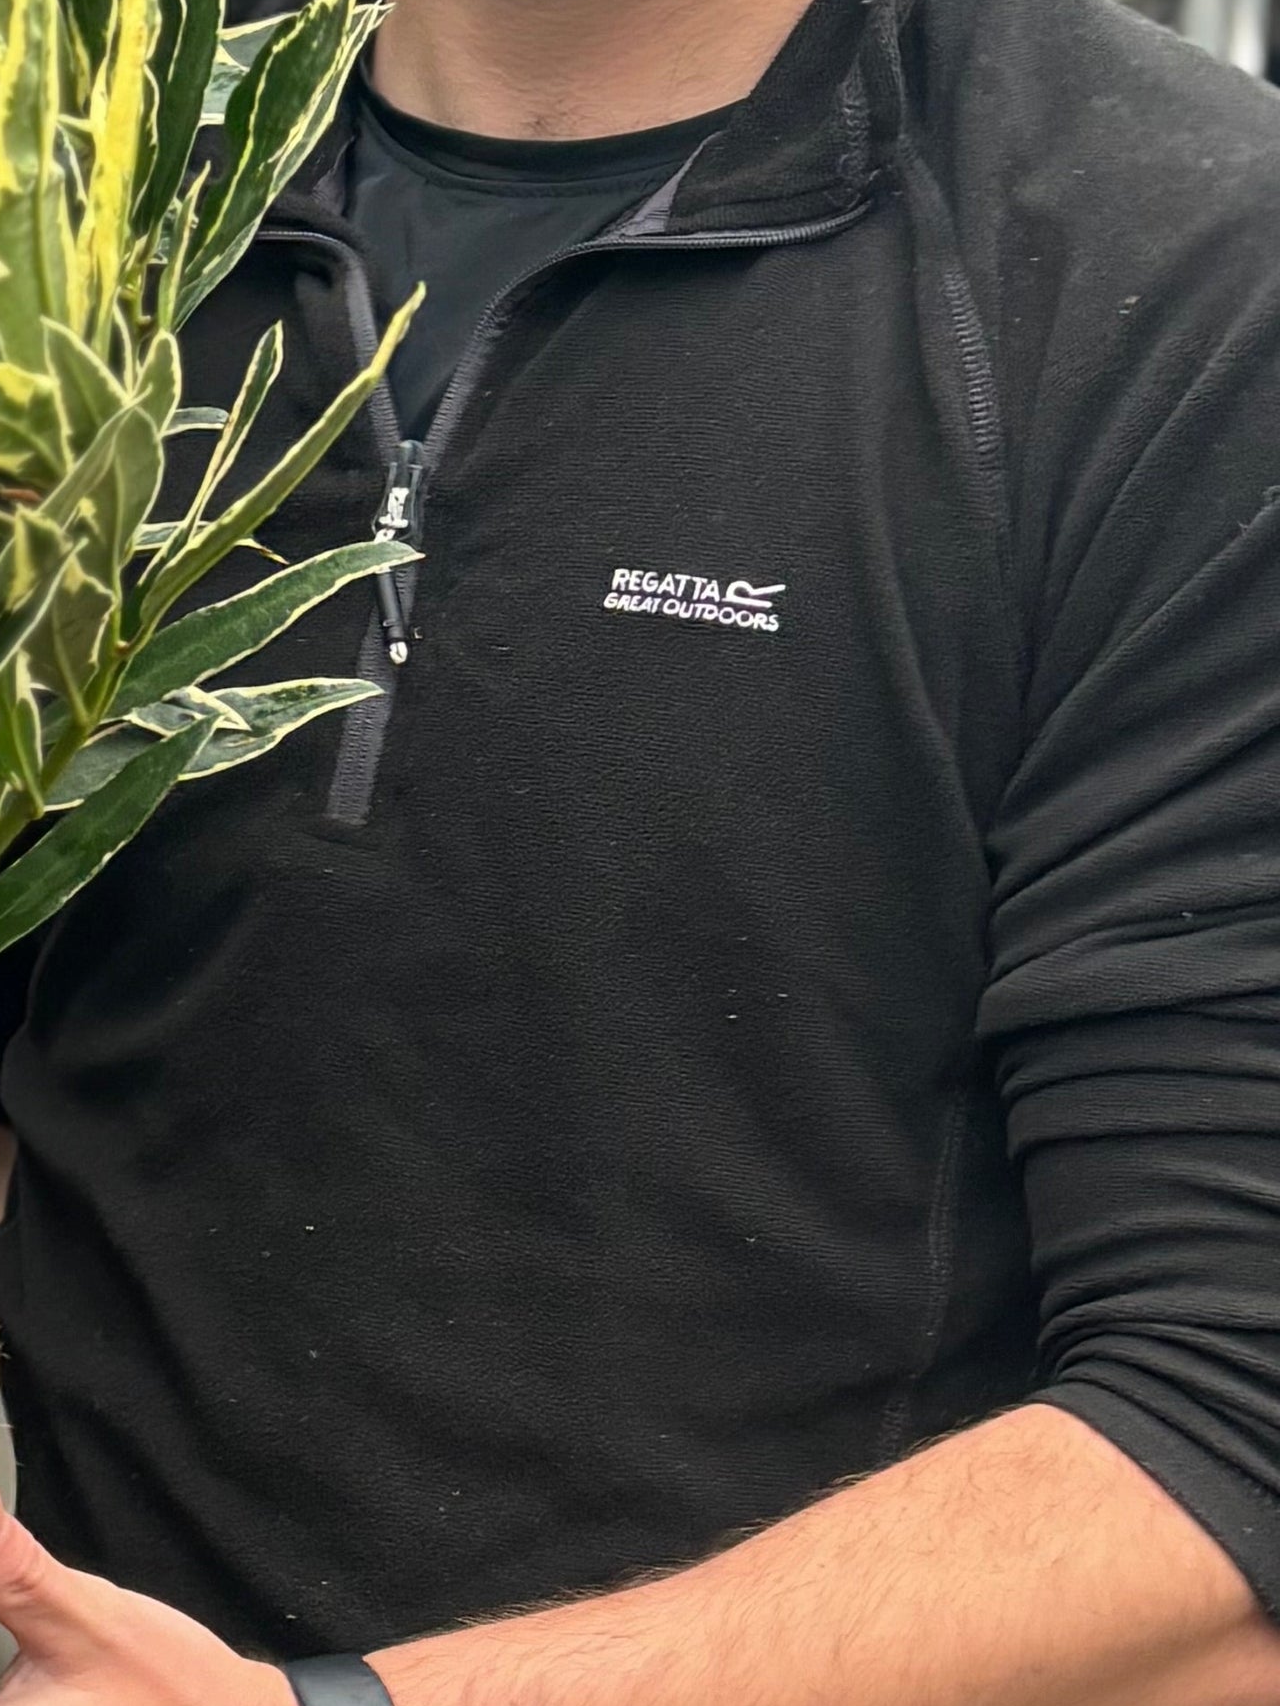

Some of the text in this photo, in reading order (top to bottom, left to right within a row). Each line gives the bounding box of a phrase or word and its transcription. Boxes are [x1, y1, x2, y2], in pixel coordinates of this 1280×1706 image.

[612, 568, 720, 602] REGATTA
[603, 593, 779, 631] GREAT OUTDOORS
